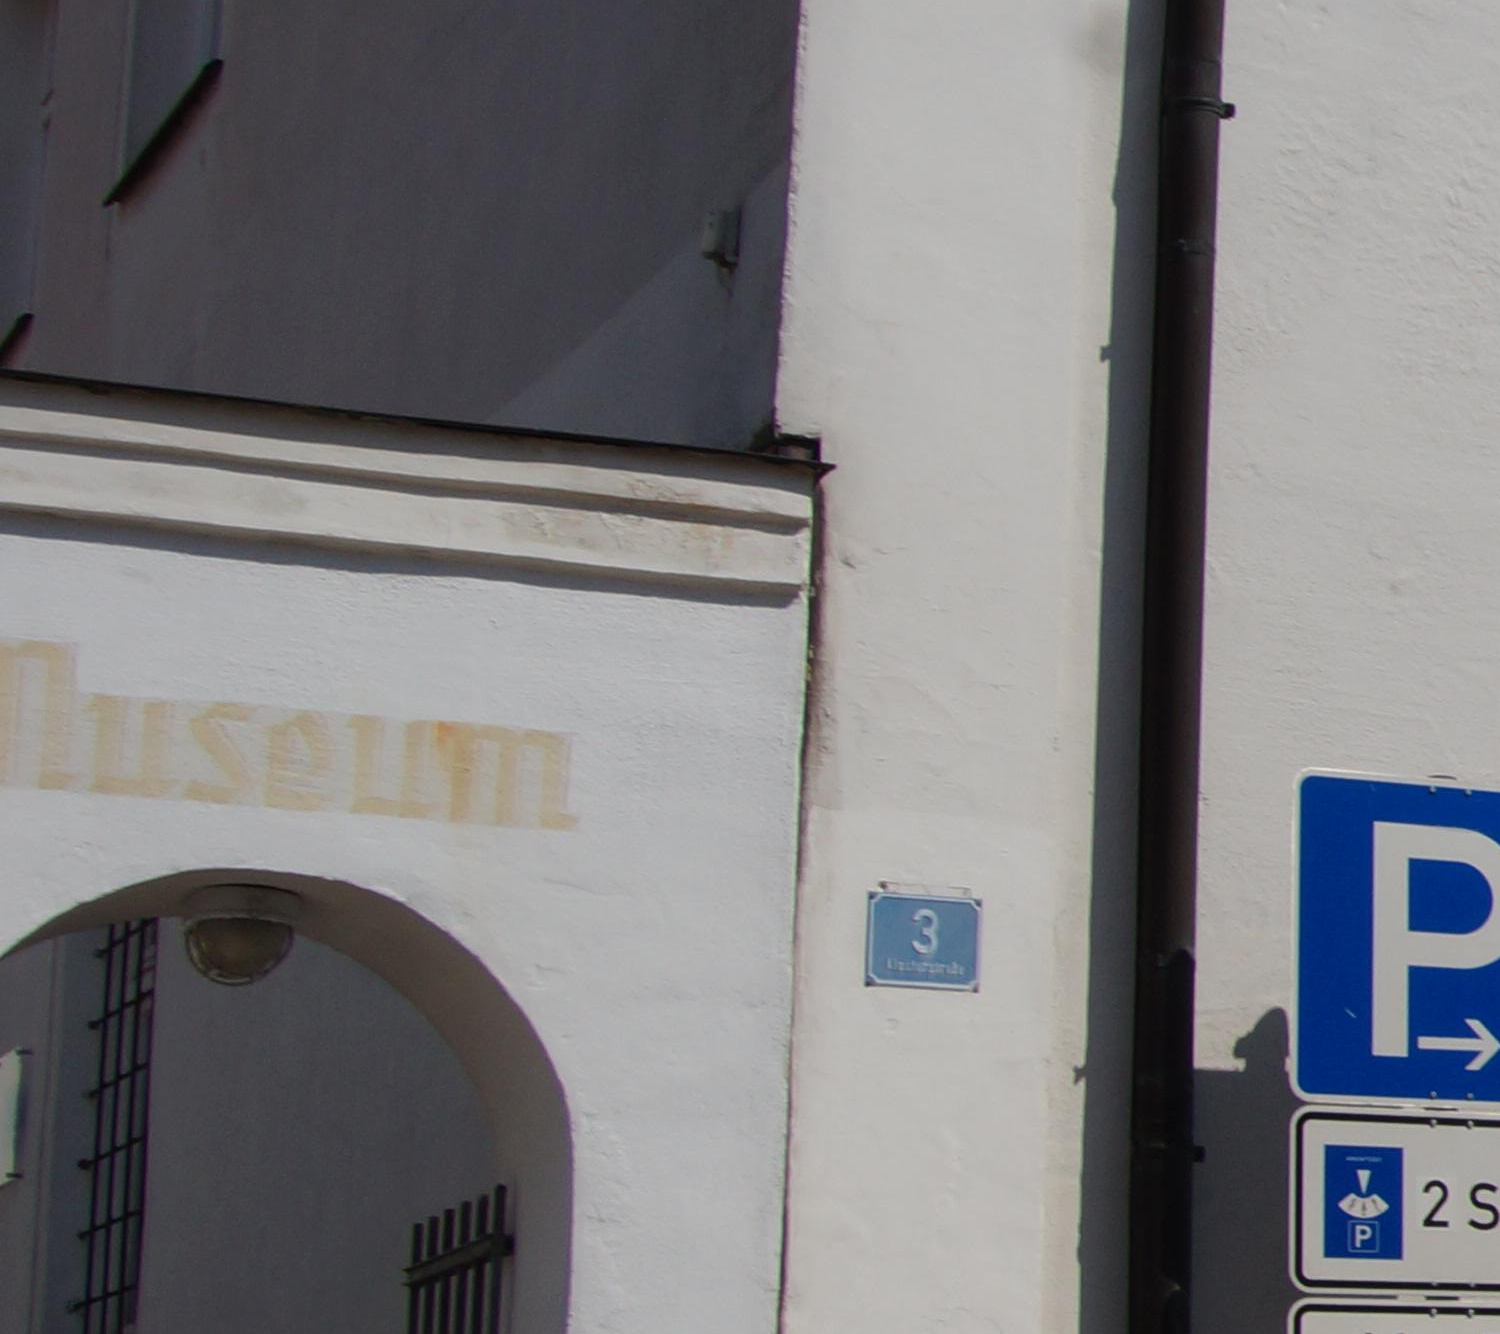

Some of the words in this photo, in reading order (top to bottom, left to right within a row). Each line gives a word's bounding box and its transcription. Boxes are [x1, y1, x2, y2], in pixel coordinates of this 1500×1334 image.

[911, 907, 939, 955] 3
[1422, 1179, 1450, 1228] 2
[1354, 1223, 1373, 1249] P
